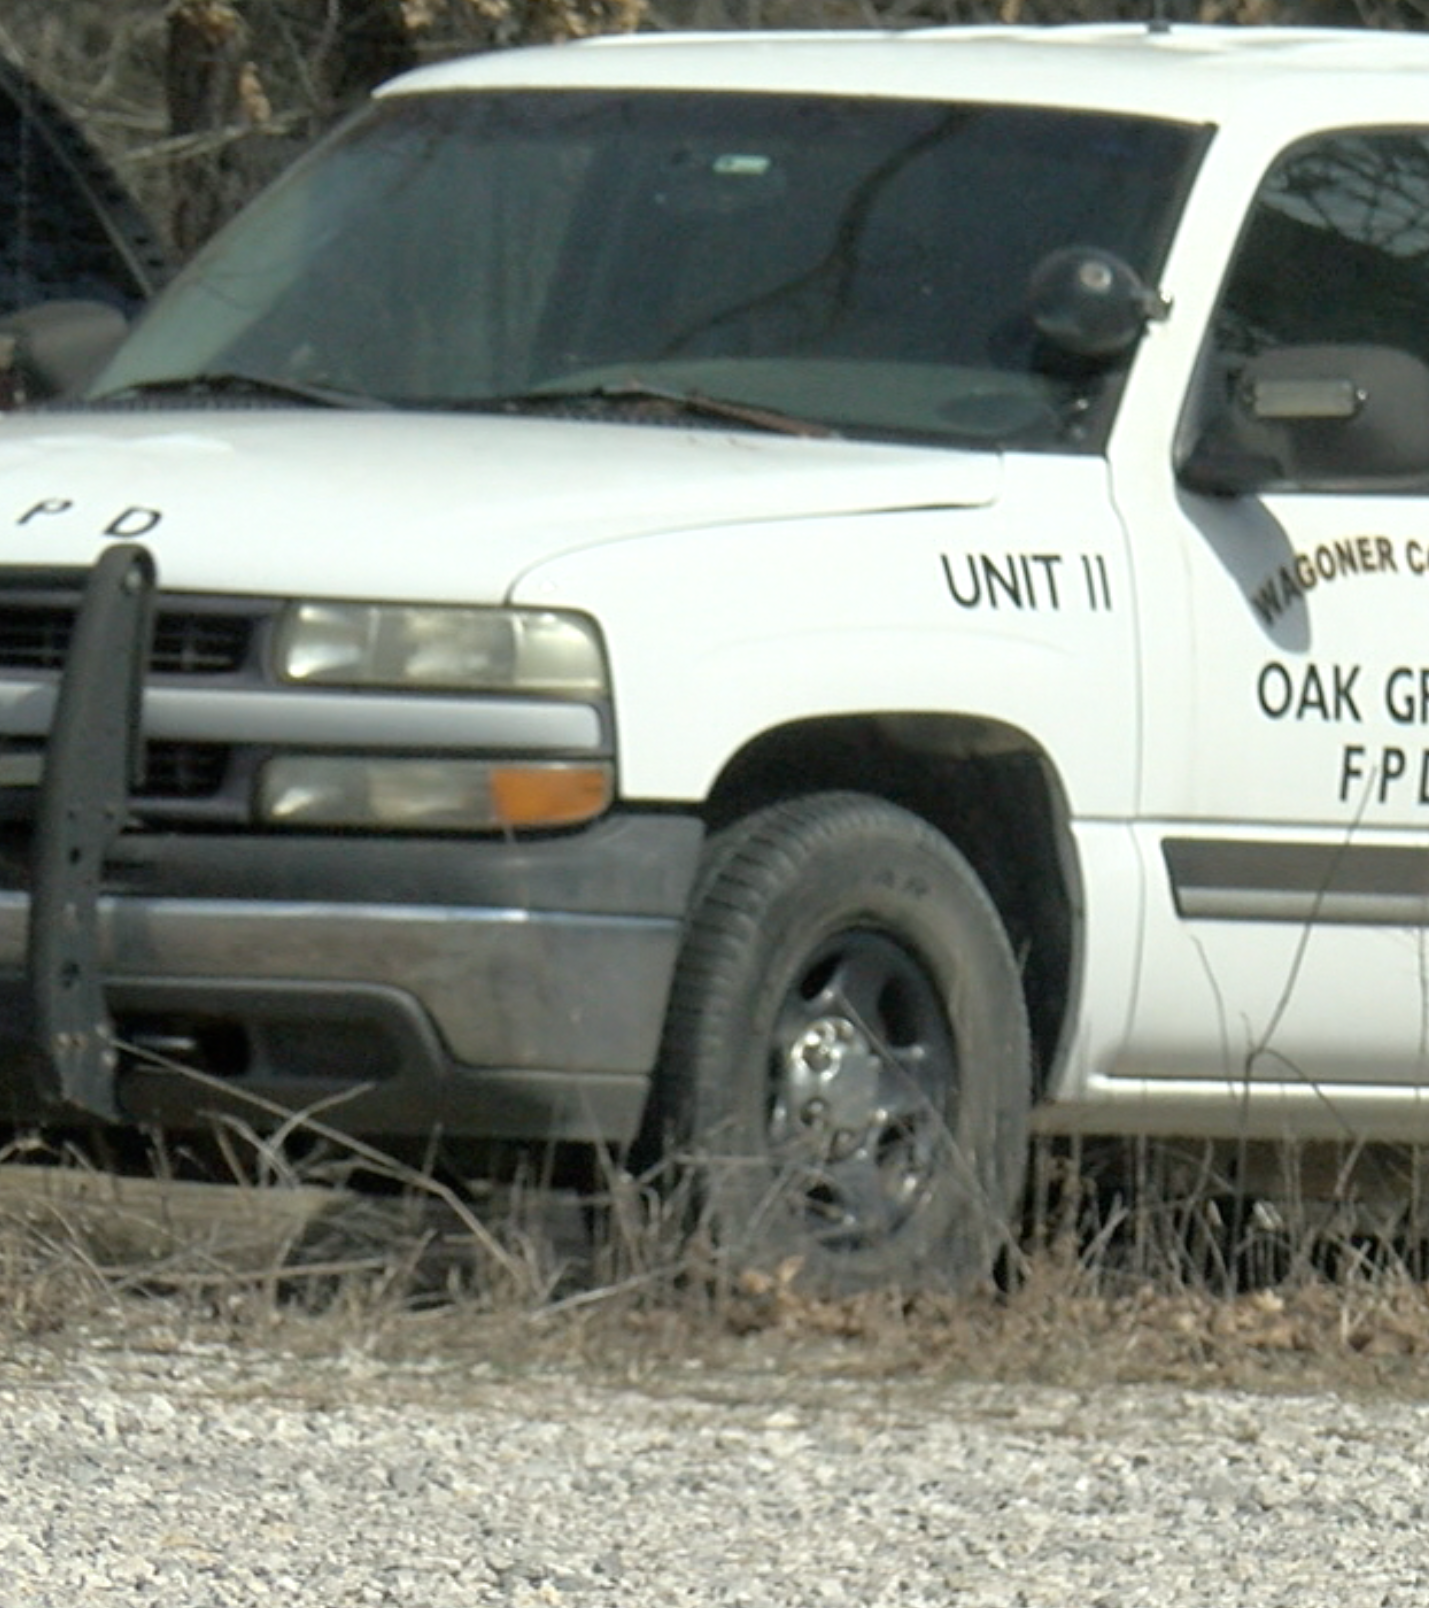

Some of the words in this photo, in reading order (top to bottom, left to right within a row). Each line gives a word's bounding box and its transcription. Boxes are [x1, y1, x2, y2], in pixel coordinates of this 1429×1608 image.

[940, 553, 1063, 610] UNIT
[1251, 537, 1397, 627] WAGONER
[1258, 661, 1363, 722] OAK
